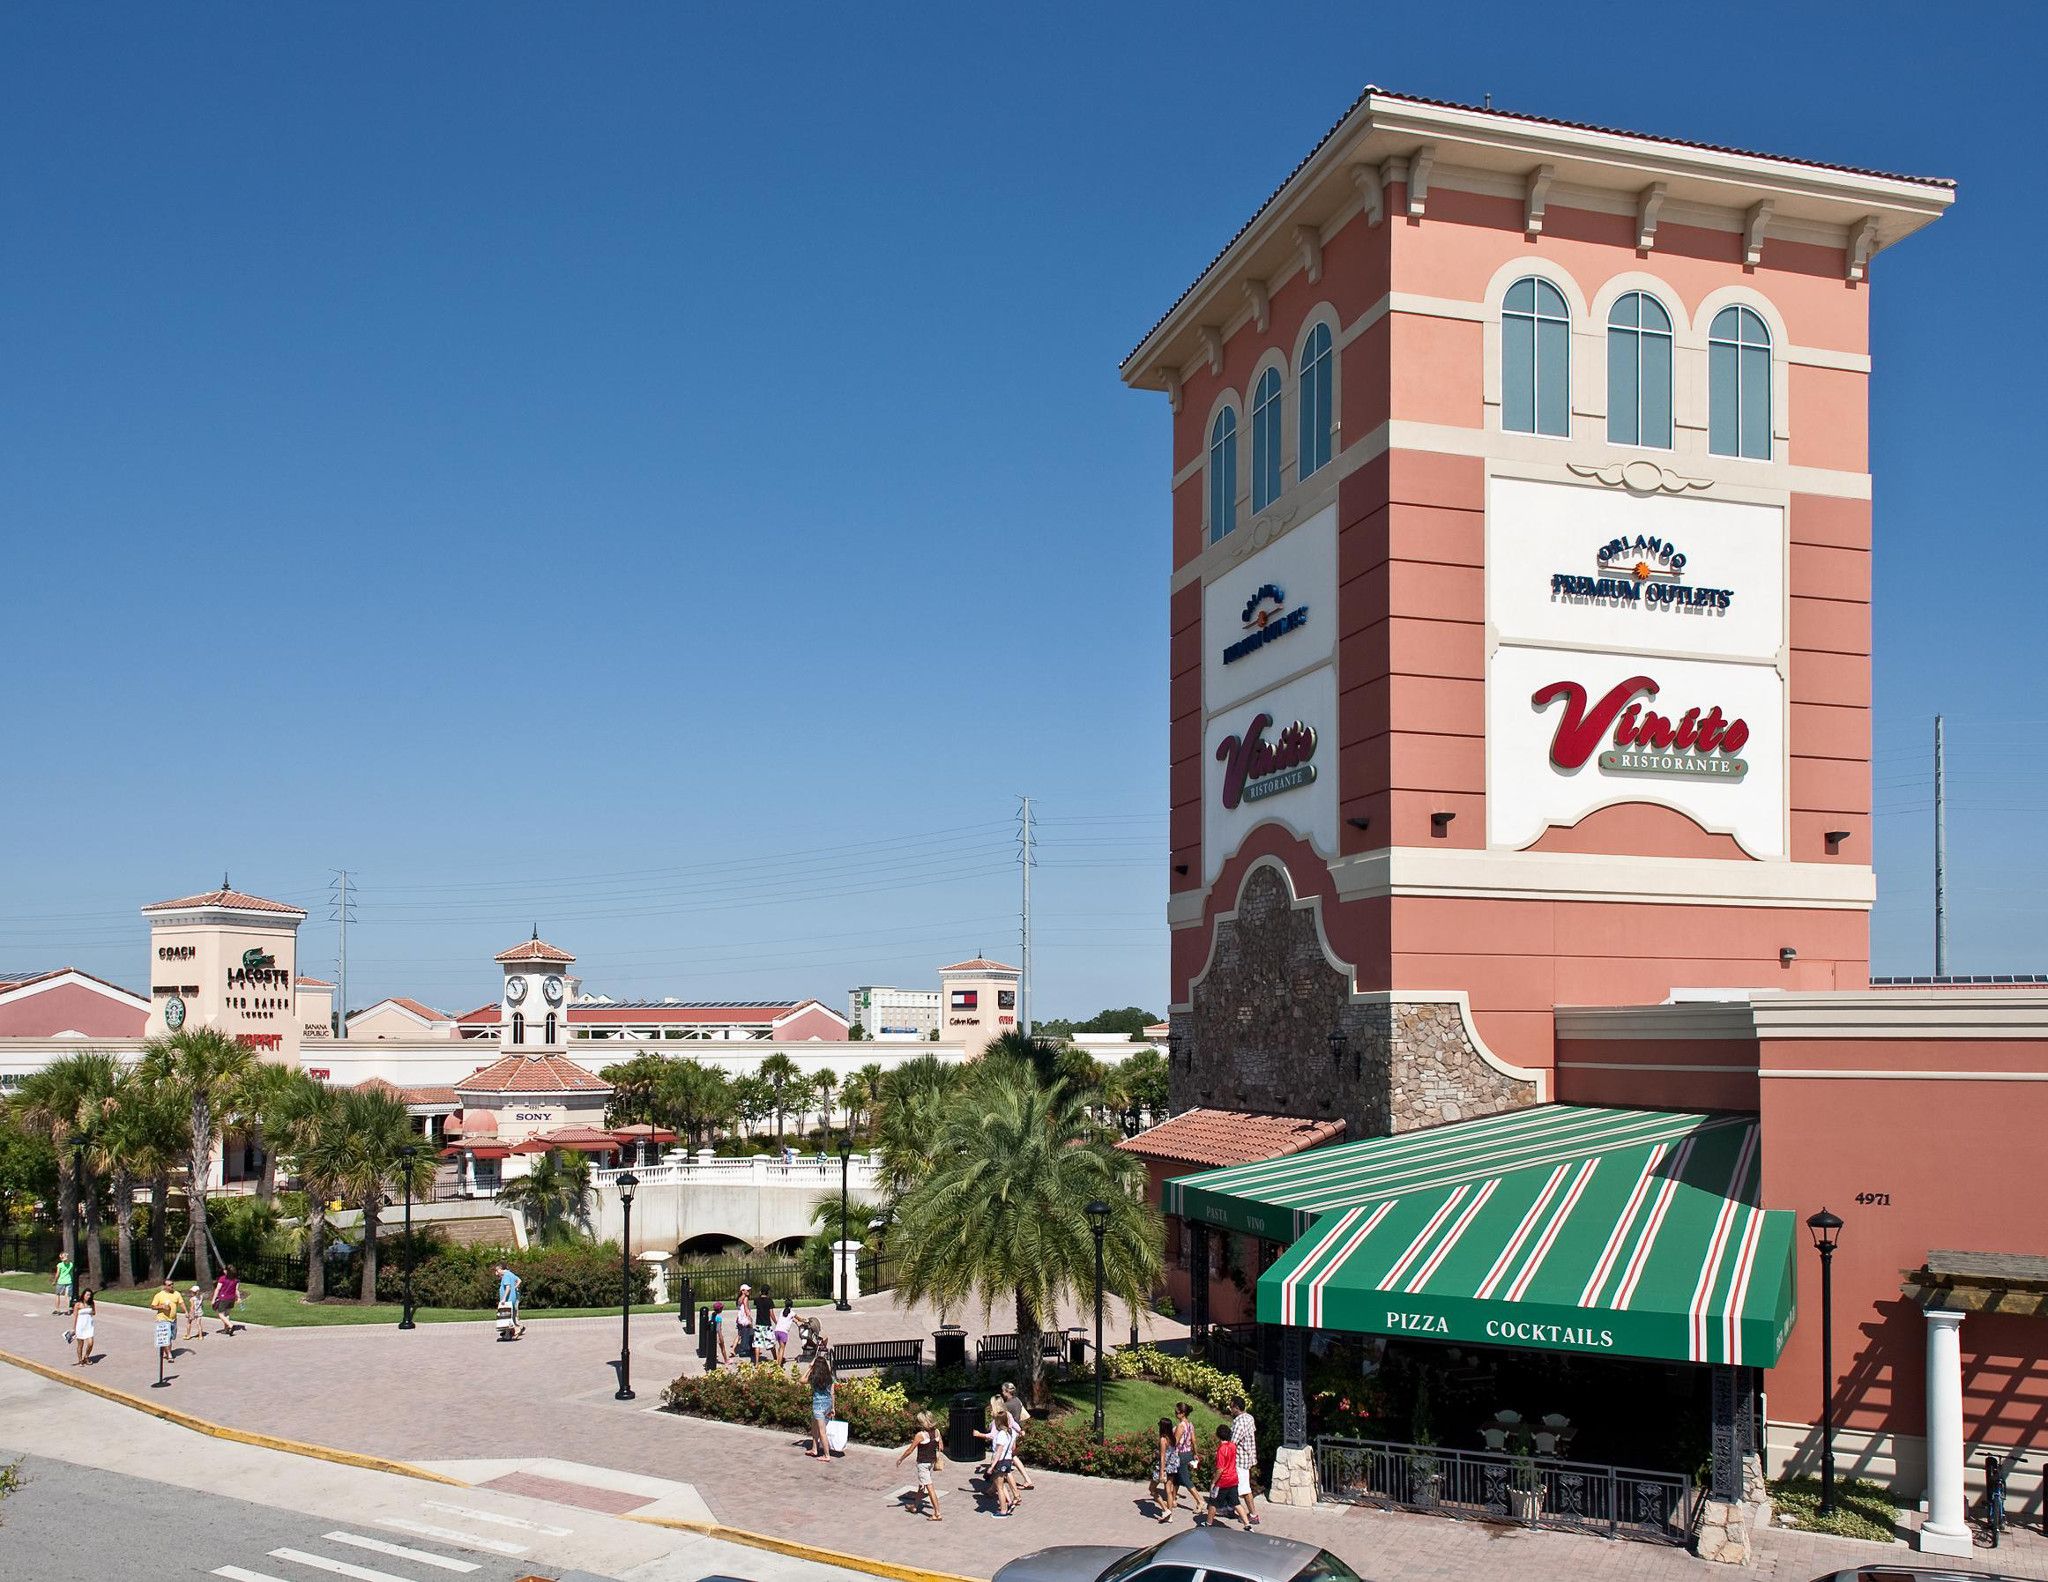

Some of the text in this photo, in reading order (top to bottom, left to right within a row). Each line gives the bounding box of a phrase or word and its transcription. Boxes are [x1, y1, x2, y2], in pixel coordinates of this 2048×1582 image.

[1598, 534, 1687, 569] ORLANDO
[1552, 573, 1734, 609] PREMIUM OUTLETS
[1531, 675, 1750, 770] Vinito
[1621, 754, 1731, 774] RISTORANTE
[1249, 771, 1303, 799] RISTORANTE
[158, 946, 196, 957] COACH
[227, 967, 289, 985] LACOSTE
[226, 997, 247, 1010] TED
[516, 1113, 552, 1121] SONY
[1855, 1192, 1891, 1206] 4971
[1206, 1205, 1266, 1232] PASTA VINO
[1386, 1311, 1615, 1347] PIZZA COCKTAILS
